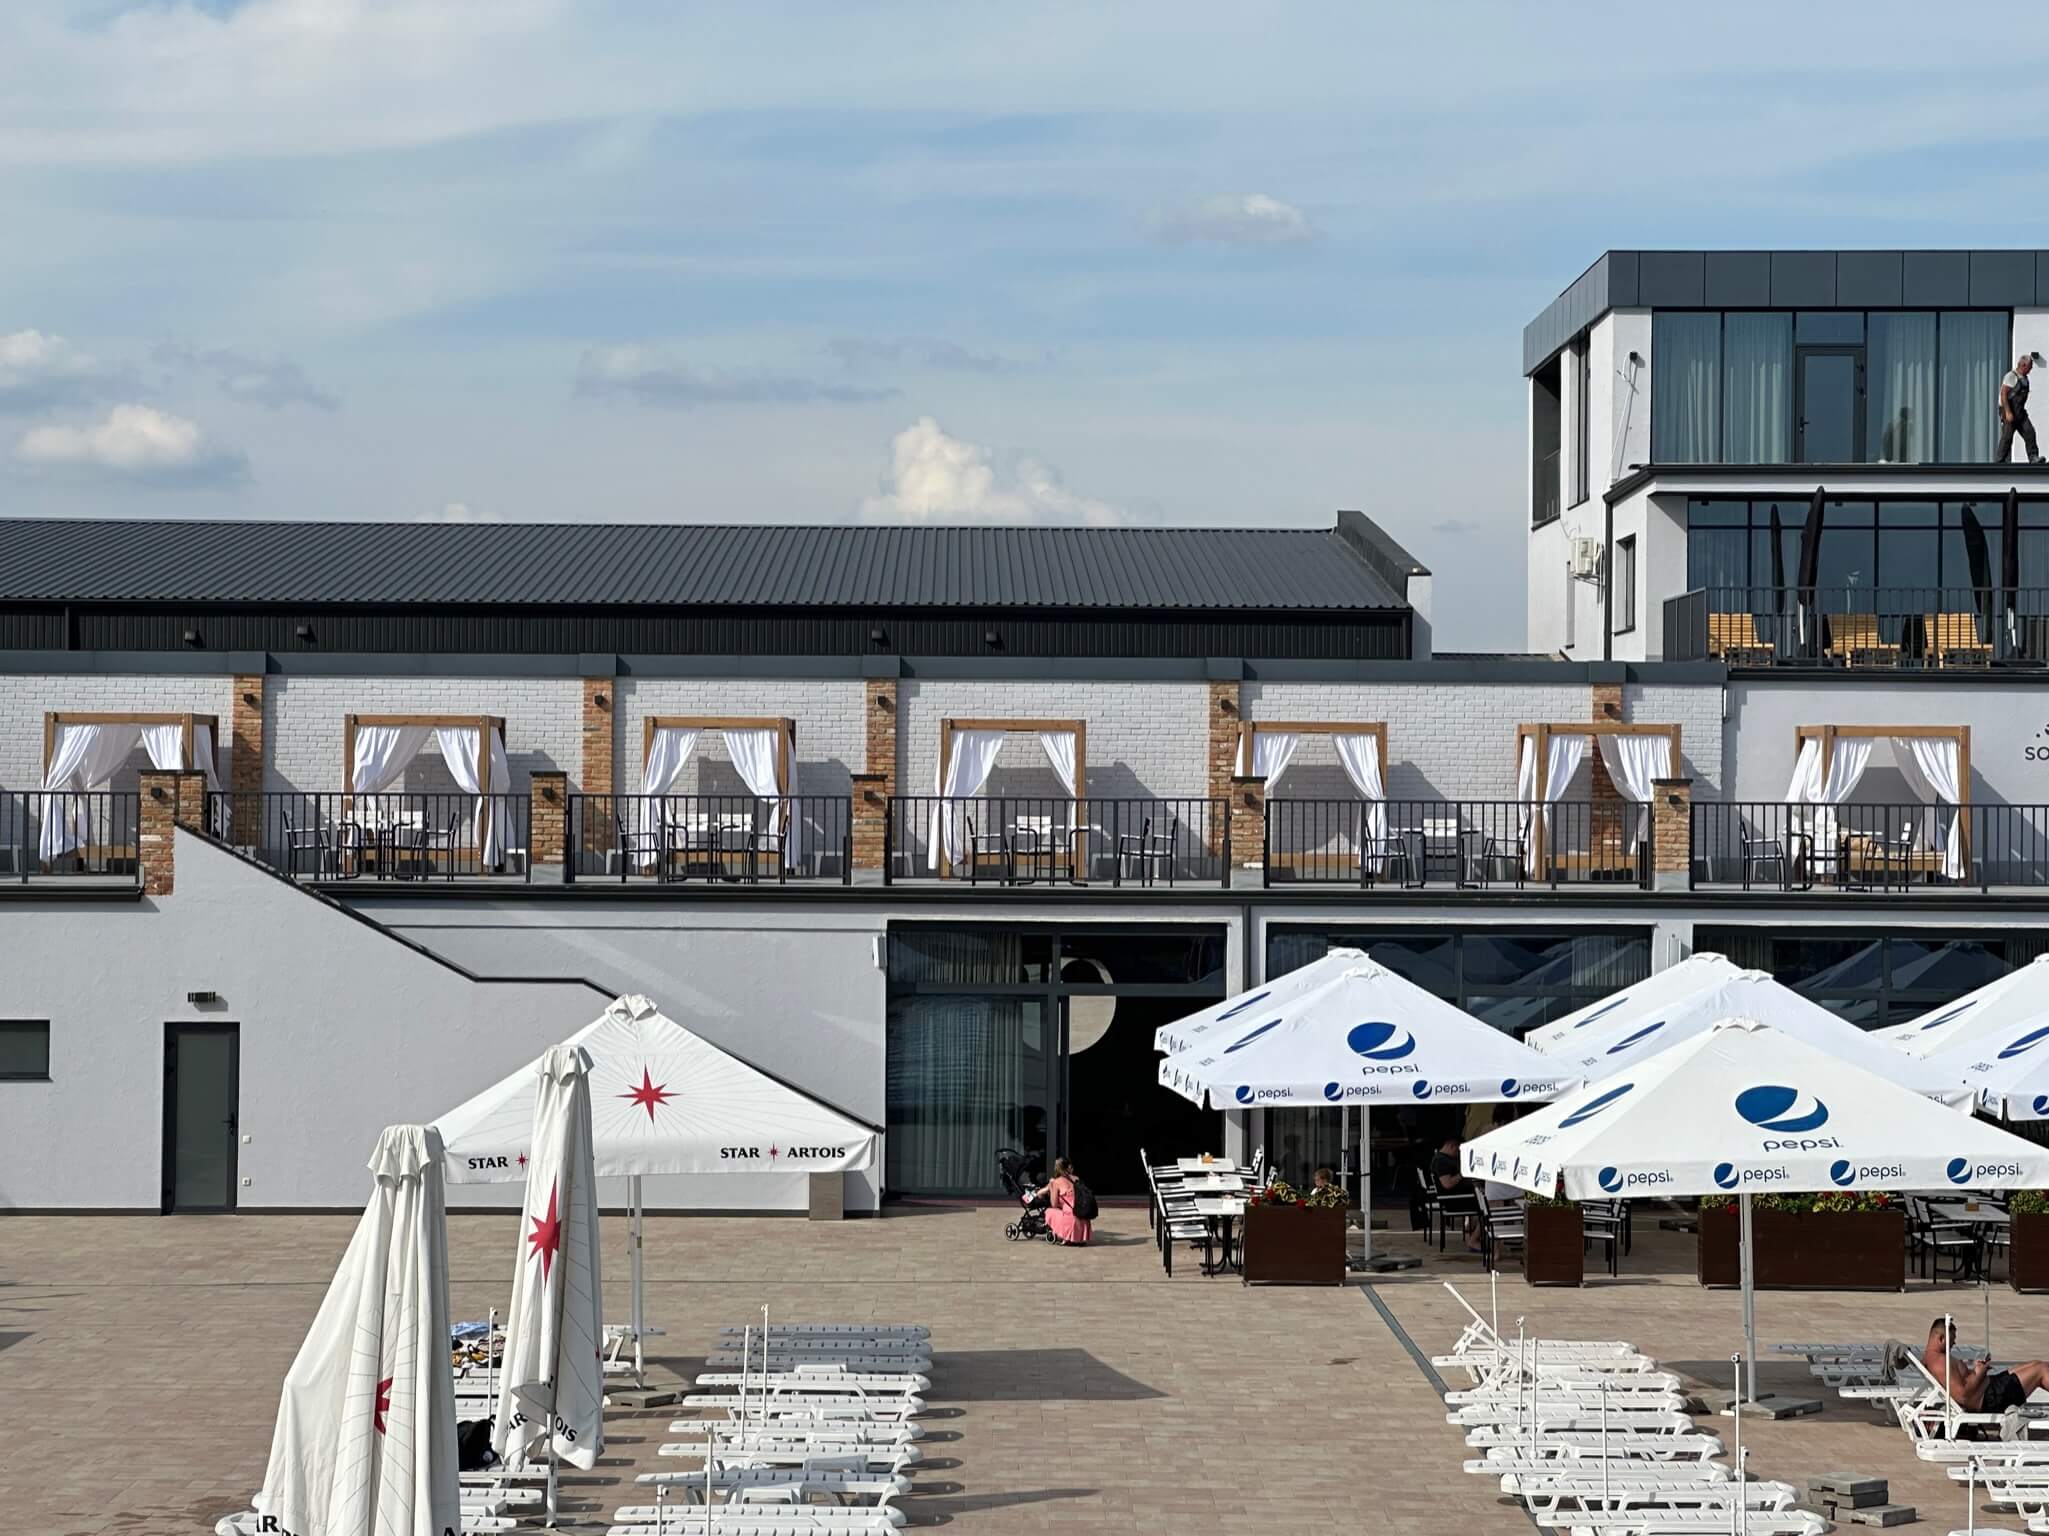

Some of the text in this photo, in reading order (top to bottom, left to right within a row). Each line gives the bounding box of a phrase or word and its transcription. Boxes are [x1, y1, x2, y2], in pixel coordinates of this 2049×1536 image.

[1763, 1136, 1841, 1153] pepsi
[720, 1146, 846, 1159] STAR ARTOIS
[468, 1156, 508, 1169] STAR
[1627, 1162, 2019, 1187] pepsi pepsi pepsi pepsi
